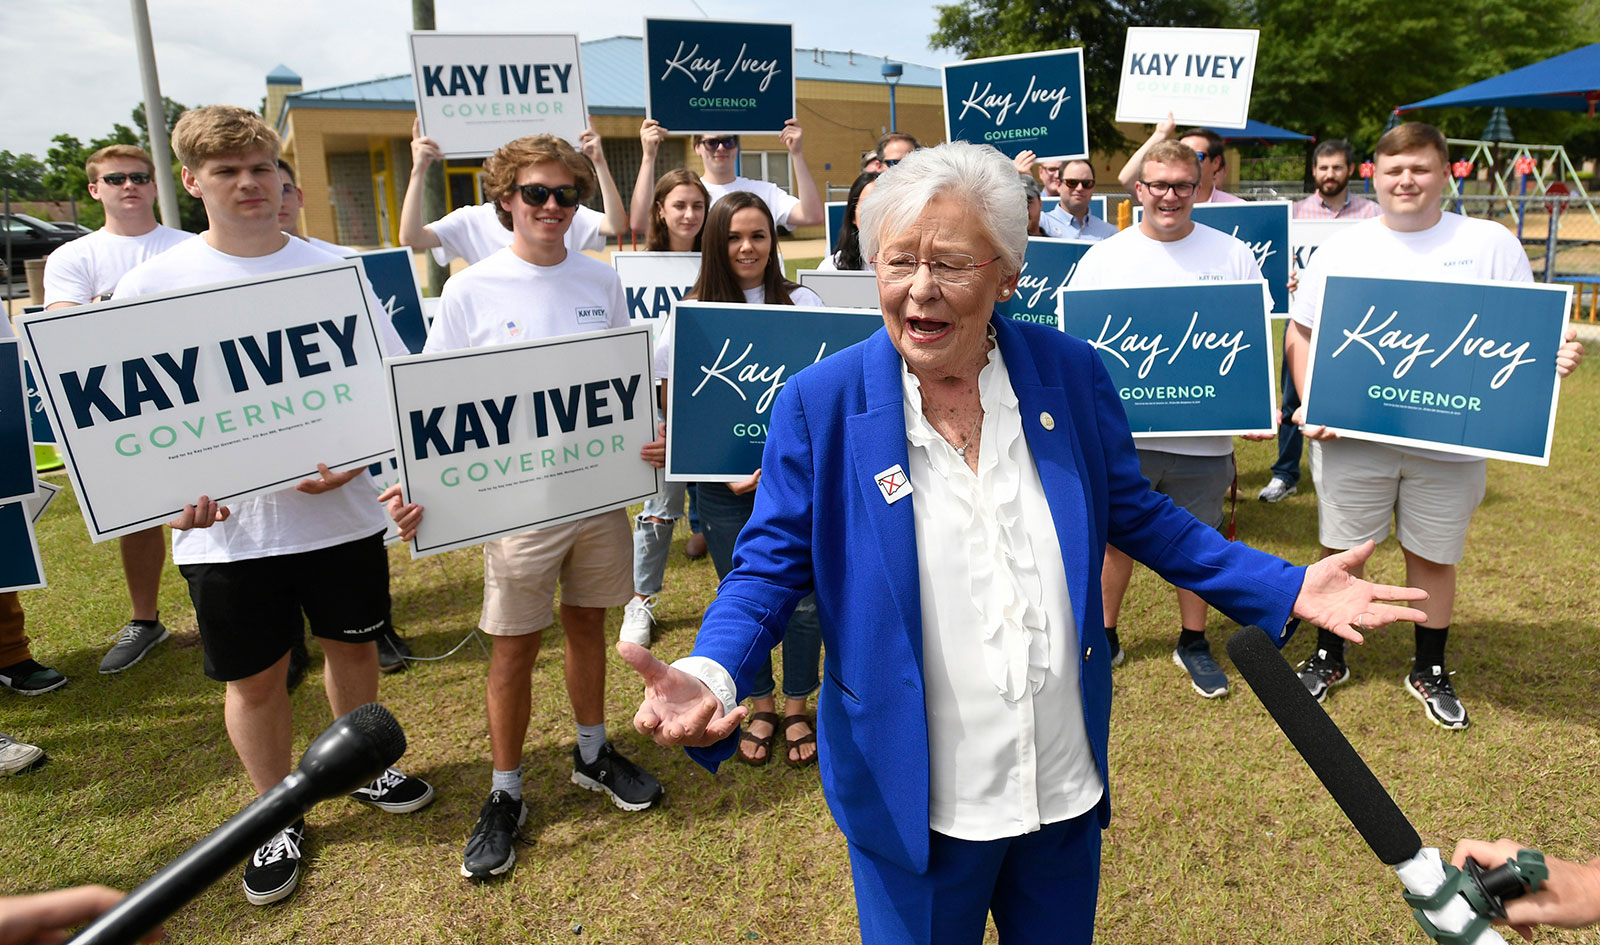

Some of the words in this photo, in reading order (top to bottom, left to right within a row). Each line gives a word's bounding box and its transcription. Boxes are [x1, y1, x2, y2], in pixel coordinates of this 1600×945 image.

[422, 64, 488, 96] KAY
[500, 63, 572, 94] IVEY
[660, 40, 725, 92] Kay
[724, 43, 781, 92] Ivey
[1130, 53, 1179, 76] KAY
[1186, 54, 1244, 78] IVEY
[689, 96, 756, 108] GOVERNOR
[958, 81, 1016, 125] Kay
[1015, 75, 1071, 120] Ivey
[1136, 81, 1230, 96] GOVERNOR
[442, 101, 564, 118] GOVERNOR
[984, 126, 1048, 141] GOVERNOR
[578, 310, 590, 318] KAY
[592, 308, 605, 316] IVEY
[1086, 314, 1170, 378] Kay
[1168, 311, 1251, 376] Ivey
[1332, 305, 1434, 379] Kay
[1430, 313, 1536, 390] Ivey
[59, 346, 200, 429] KAY
[220, 314, 358, 393] IVEY
[692, 339, 786, 414] Kay
[1119, 384, 1216, 401] GOVERNOR
[1368, 384, 1482, 412] GOVERNOR
[114, 384, 352, 456] GOVERNOR
[410, 395, 517, 460] KAY
[534, 374, 641, 438] IVEY
[440, 435, 625, 488] GOVERNOR
